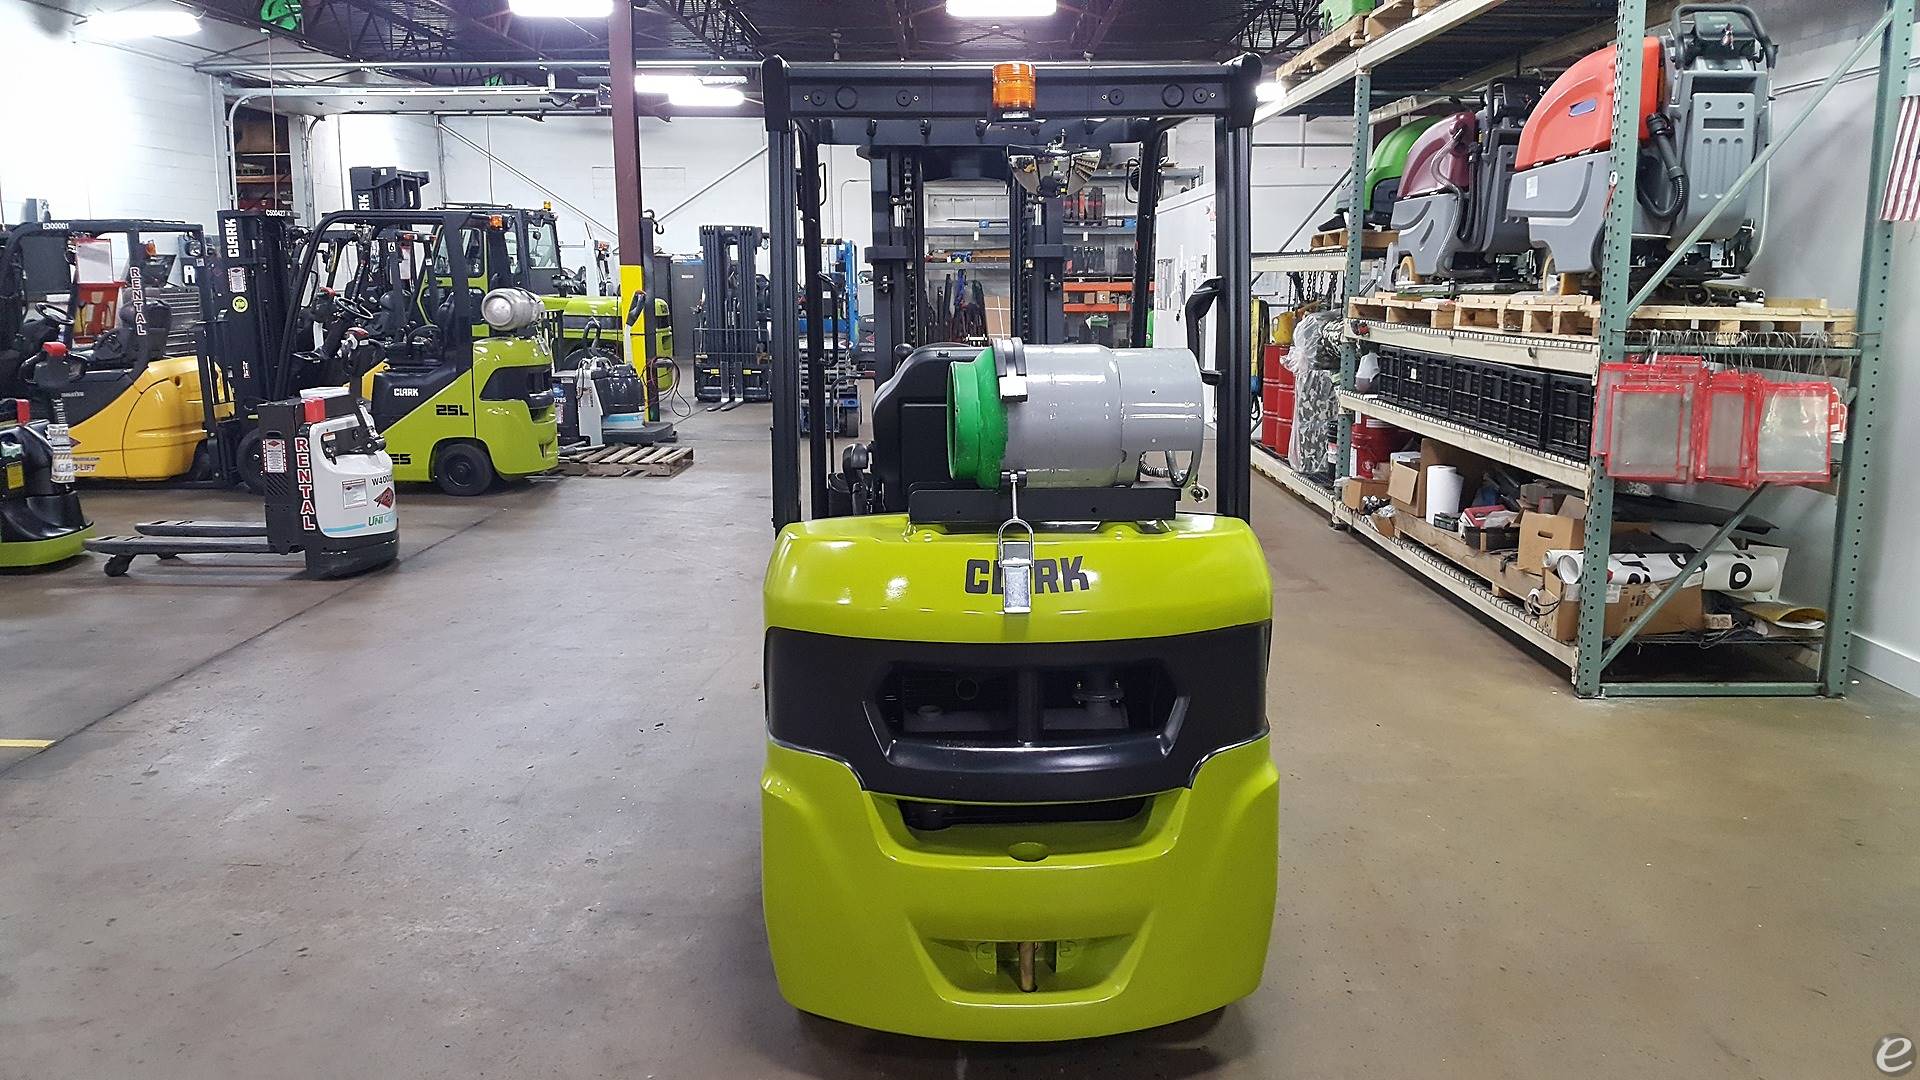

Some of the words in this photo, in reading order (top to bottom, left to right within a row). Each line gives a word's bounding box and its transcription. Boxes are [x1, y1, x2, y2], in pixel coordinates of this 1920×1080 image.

[224, 218, 240, 258] CLARK
[130, 266, 146, 336] RENTAL
[393, 388, 419, 397] CLARK
[435, 404, 469, 416] 25L
[294, 437, 316, 530] RENTAL
[964, 555, 1090, 595] CLRK
